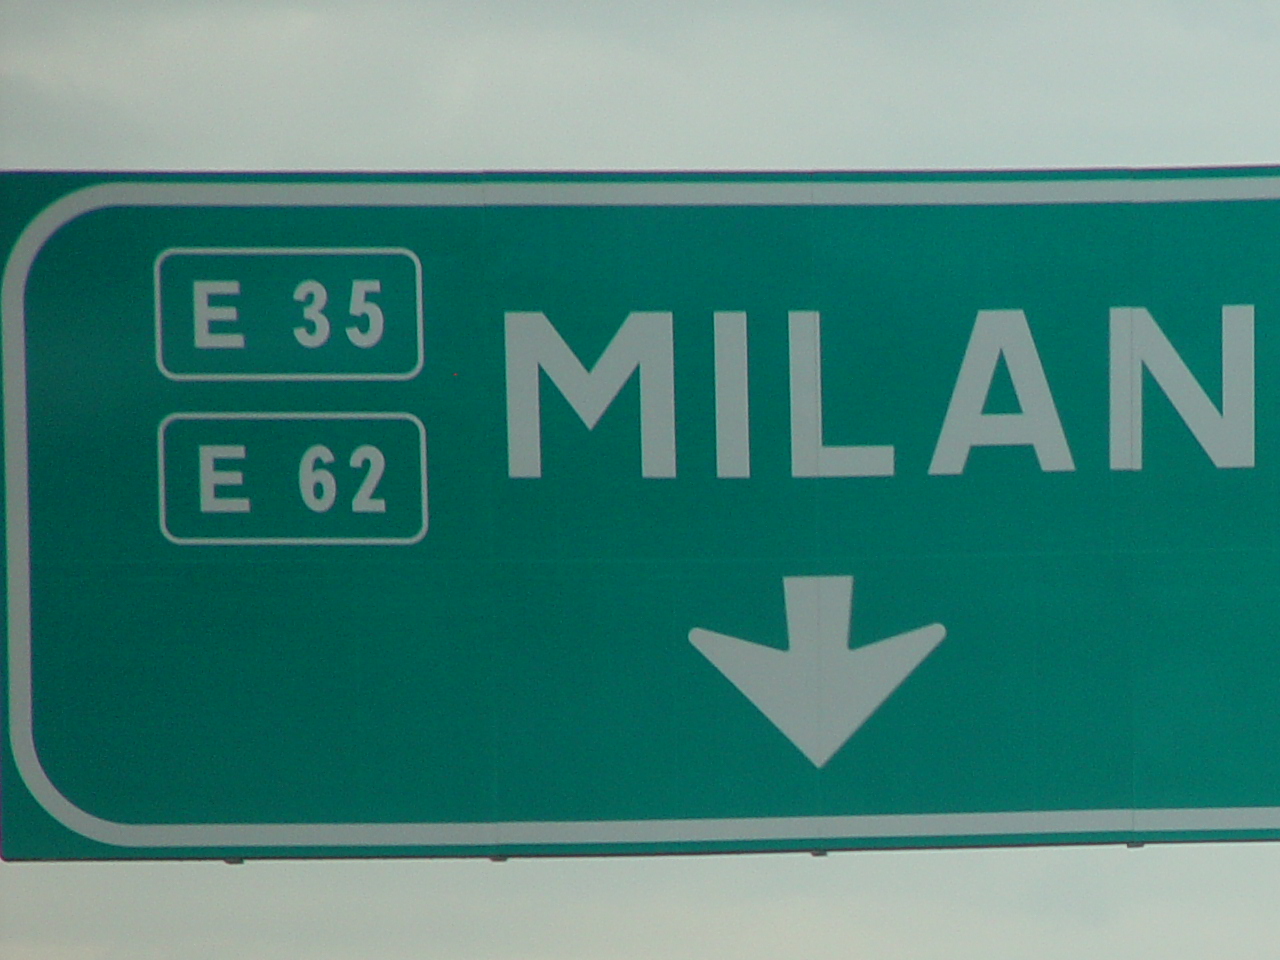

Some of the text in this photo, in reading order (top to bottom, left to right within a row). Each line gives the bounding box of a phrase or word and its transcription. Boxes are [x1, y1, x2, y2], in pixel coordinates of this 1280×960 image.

[193, 279, 385, 349] E 35
[200, 444, 386, 513] E 62
